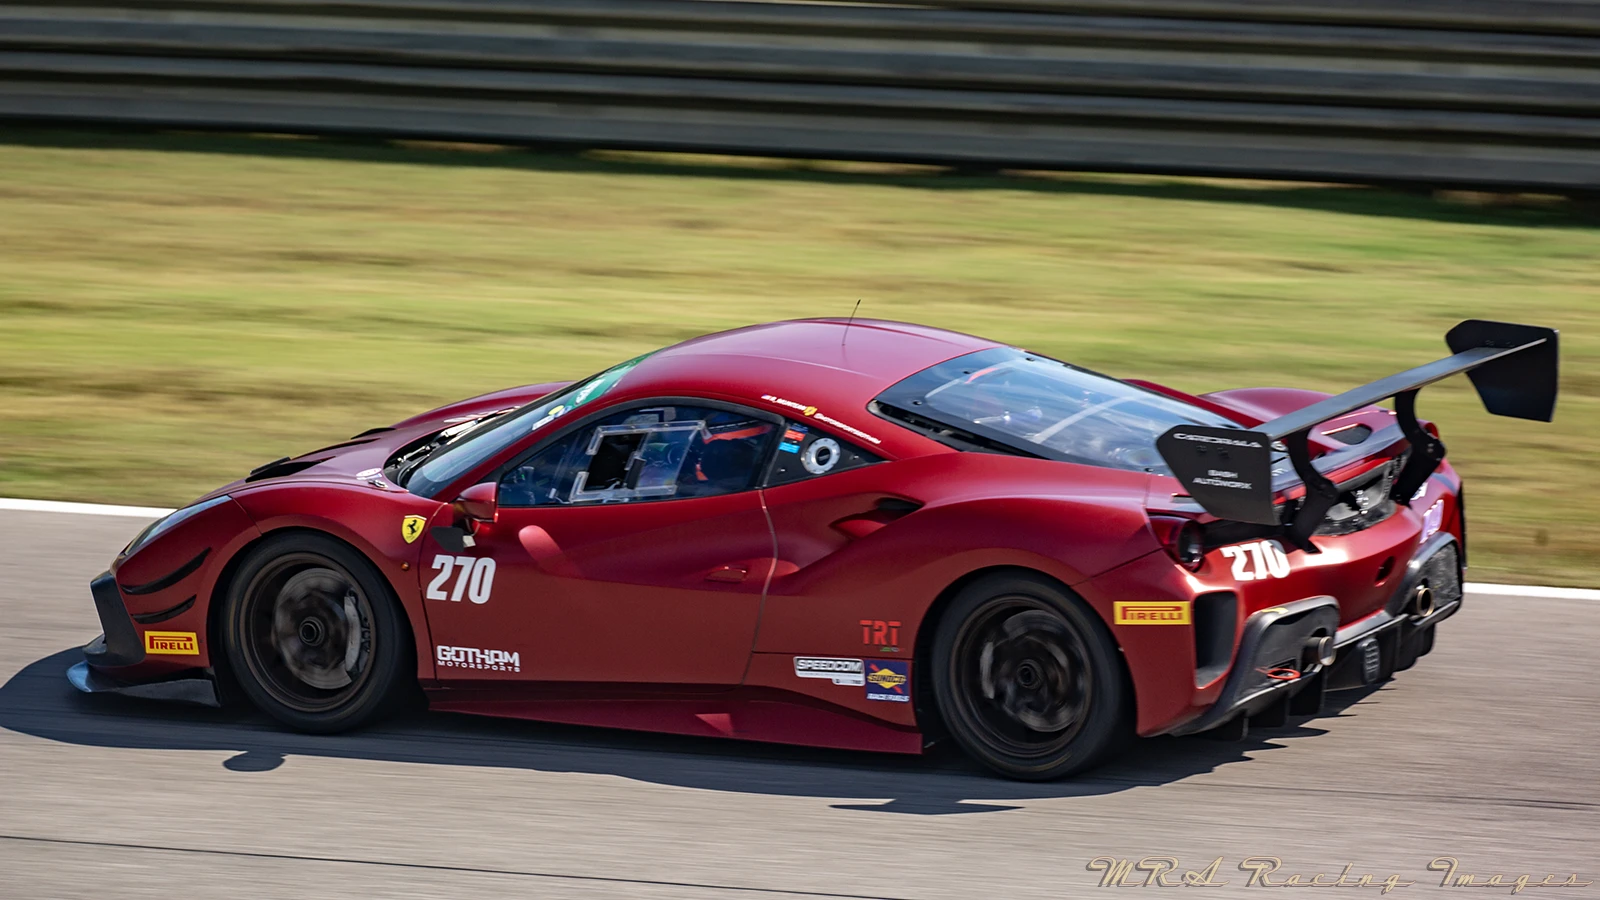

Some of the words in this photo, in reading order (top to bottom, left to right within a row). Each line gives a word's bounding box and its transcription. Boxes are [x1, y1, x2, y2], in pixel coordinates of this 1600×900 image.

[1219, 539, 1291, 581] 270
[426, 554, 497, 605] 270
[1121, 605, 1183, 621] PIRELLI
[149, 636, 193, 650] PIRELLI
[860, 620, 901, 646] TRT
[437, 645, 520, 667] GOTHAM
[437, 660, 521, 673] MOTORSPORTS
